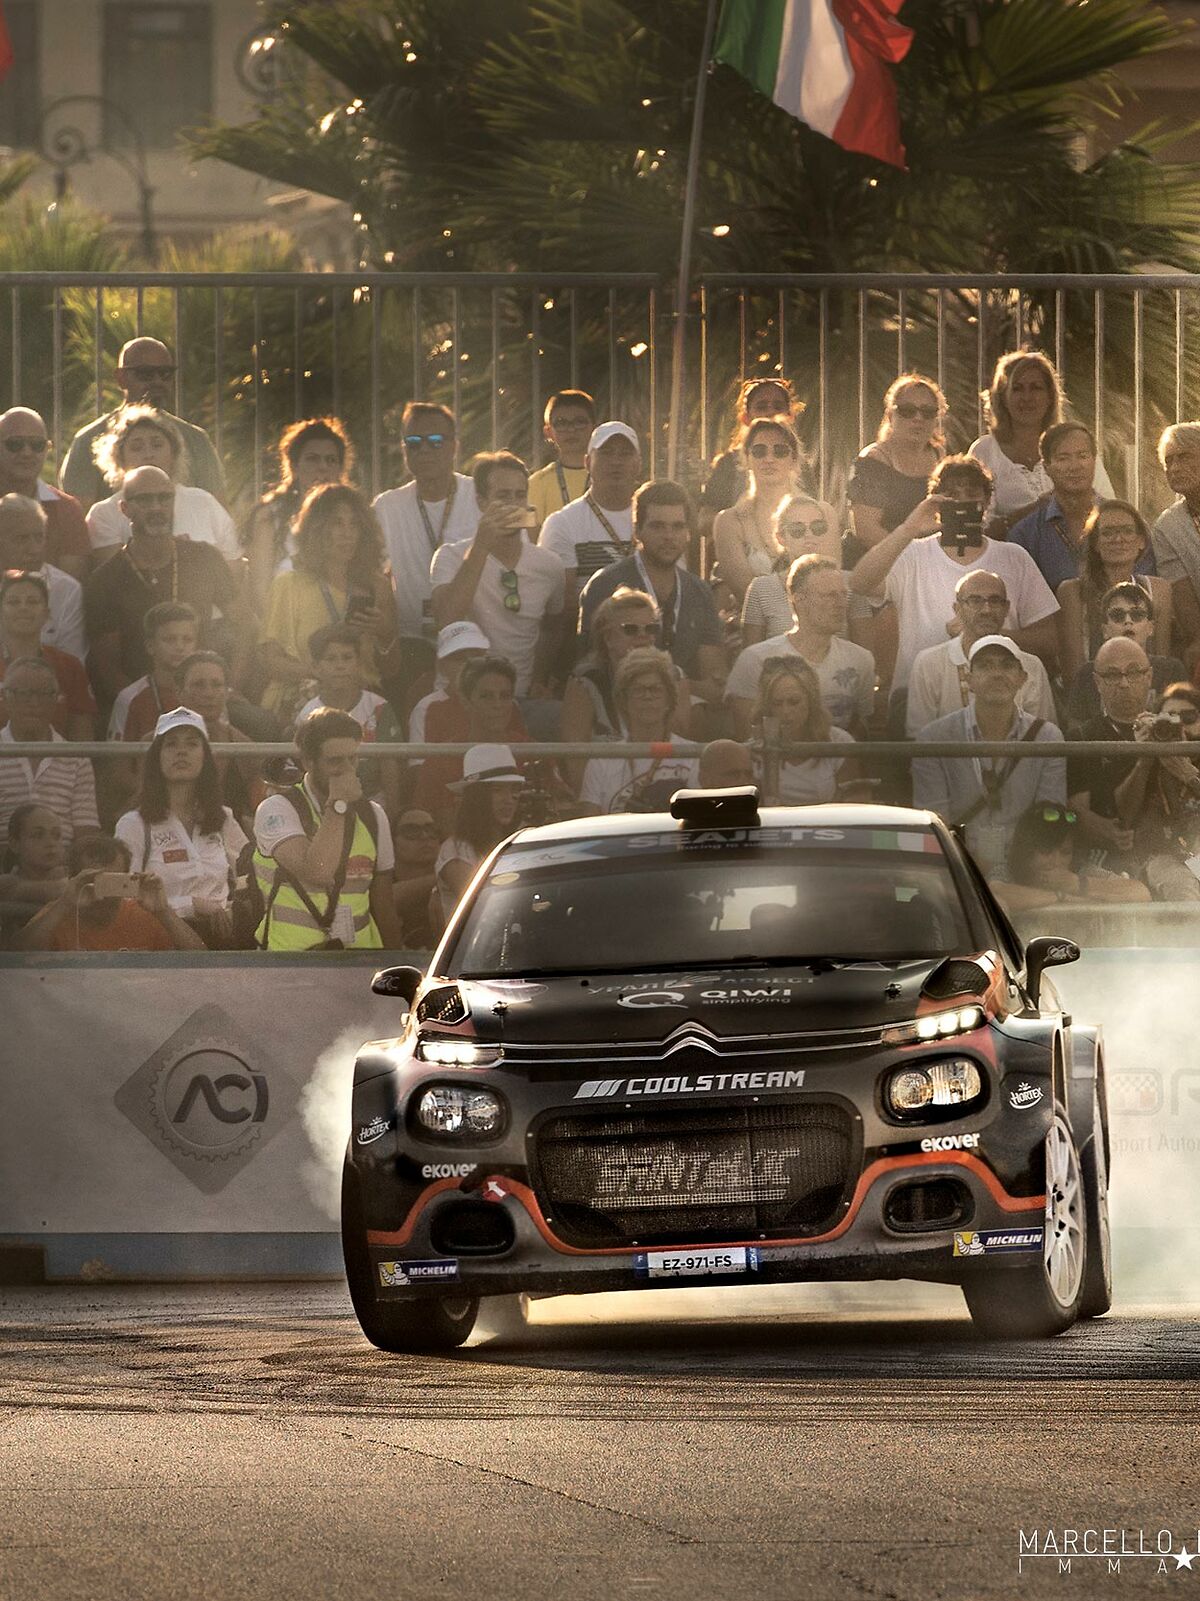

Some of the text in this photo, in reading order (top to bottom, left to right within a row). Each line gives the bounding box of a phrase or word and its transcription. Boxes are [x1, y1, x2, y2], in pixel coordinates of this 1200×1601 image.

[627, 828, 846, 848] SEAJETS
[700, 988, 791, 999] QIWI
[626, 1070, 806, 1095] COOLSTREAM
[172, 1073, 269, 1124] ACI
[1009, 1086, 1045, 1104] HORTEX
[360, 1120, 391, 1140] HORTEX
[920, 1132, 981, 1152] ekover
[421, 1163, 478, 1178] ekover
[986, 1233, 1043, 1246] MICHELIN
[409, 1265, 456, 1276] MICHELIN
[662, 1255, 732, 1271] EZ-971-FS
